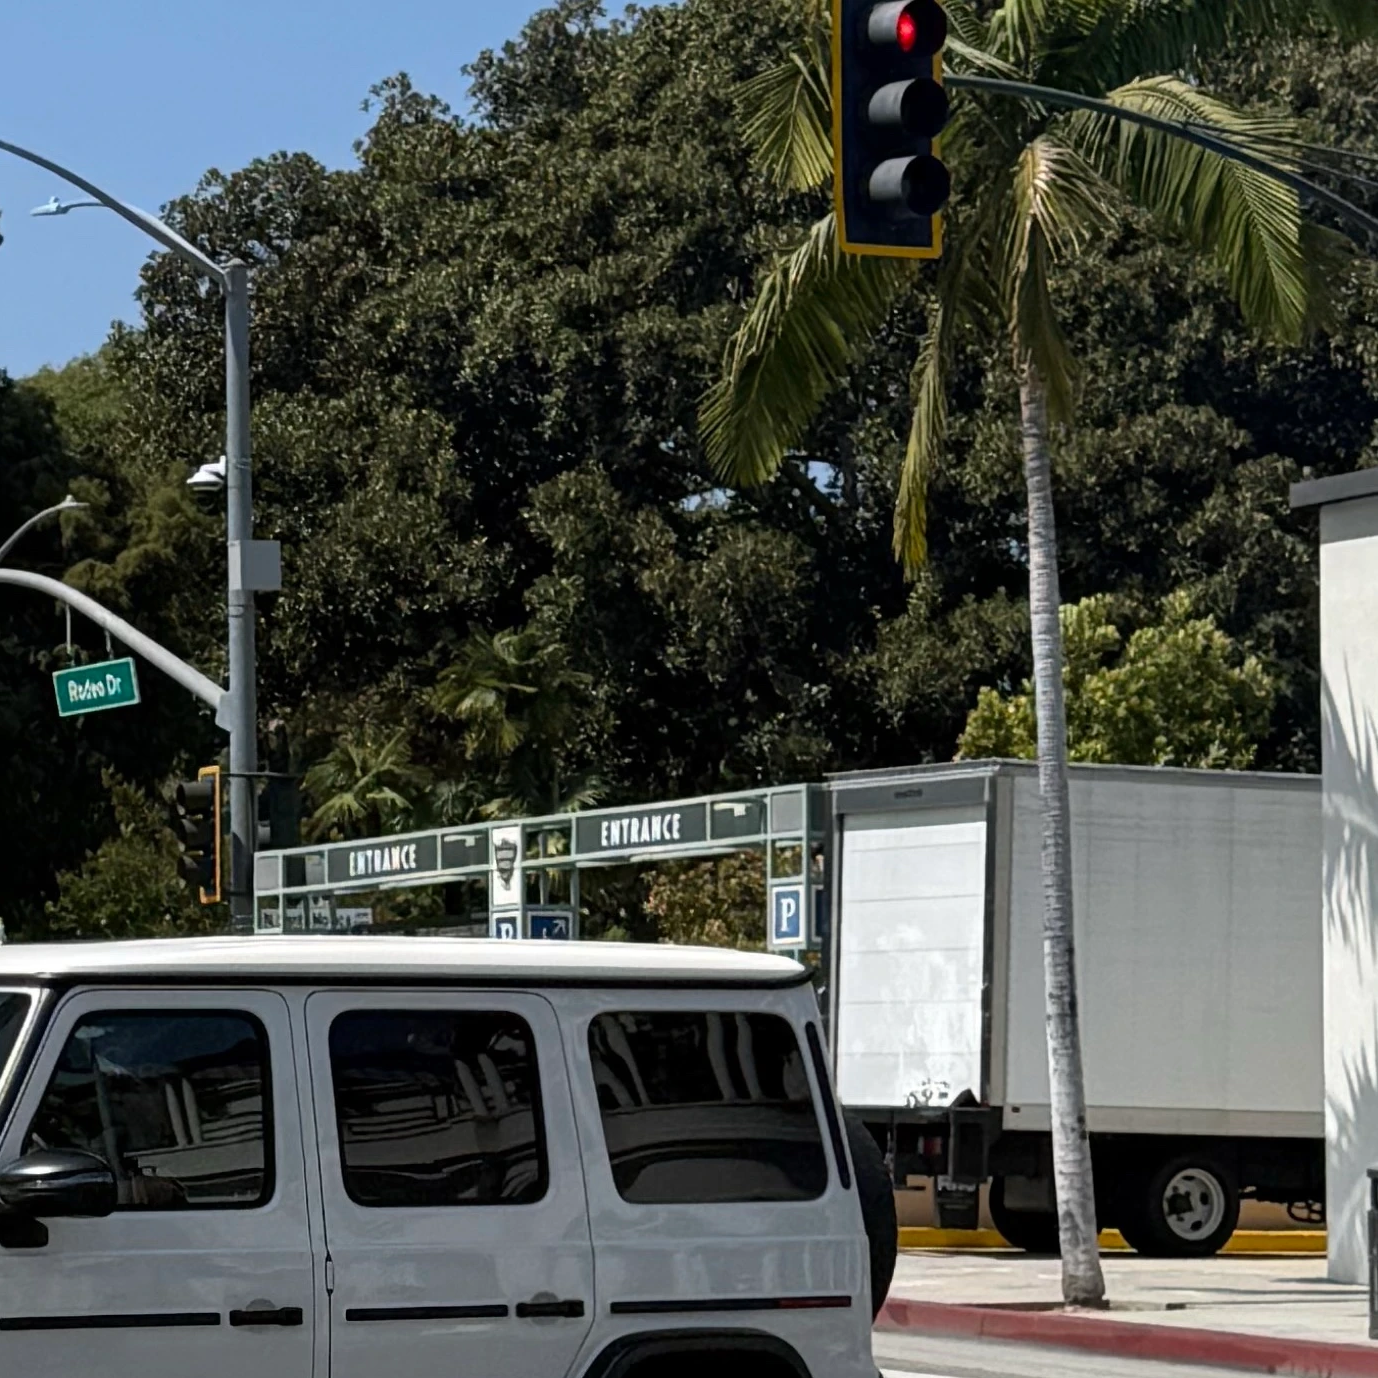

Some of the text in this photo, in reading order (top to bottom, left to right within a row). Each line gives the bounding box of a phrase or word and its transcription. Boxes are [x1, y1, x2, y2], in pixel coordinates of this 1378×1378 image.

[106, 674, 121, 695] Dr
[601, 813, 681, 847] ENTRANCE
[350, 844, 416, 876] ENTRANCE
[781, 898, 796, 931] P
